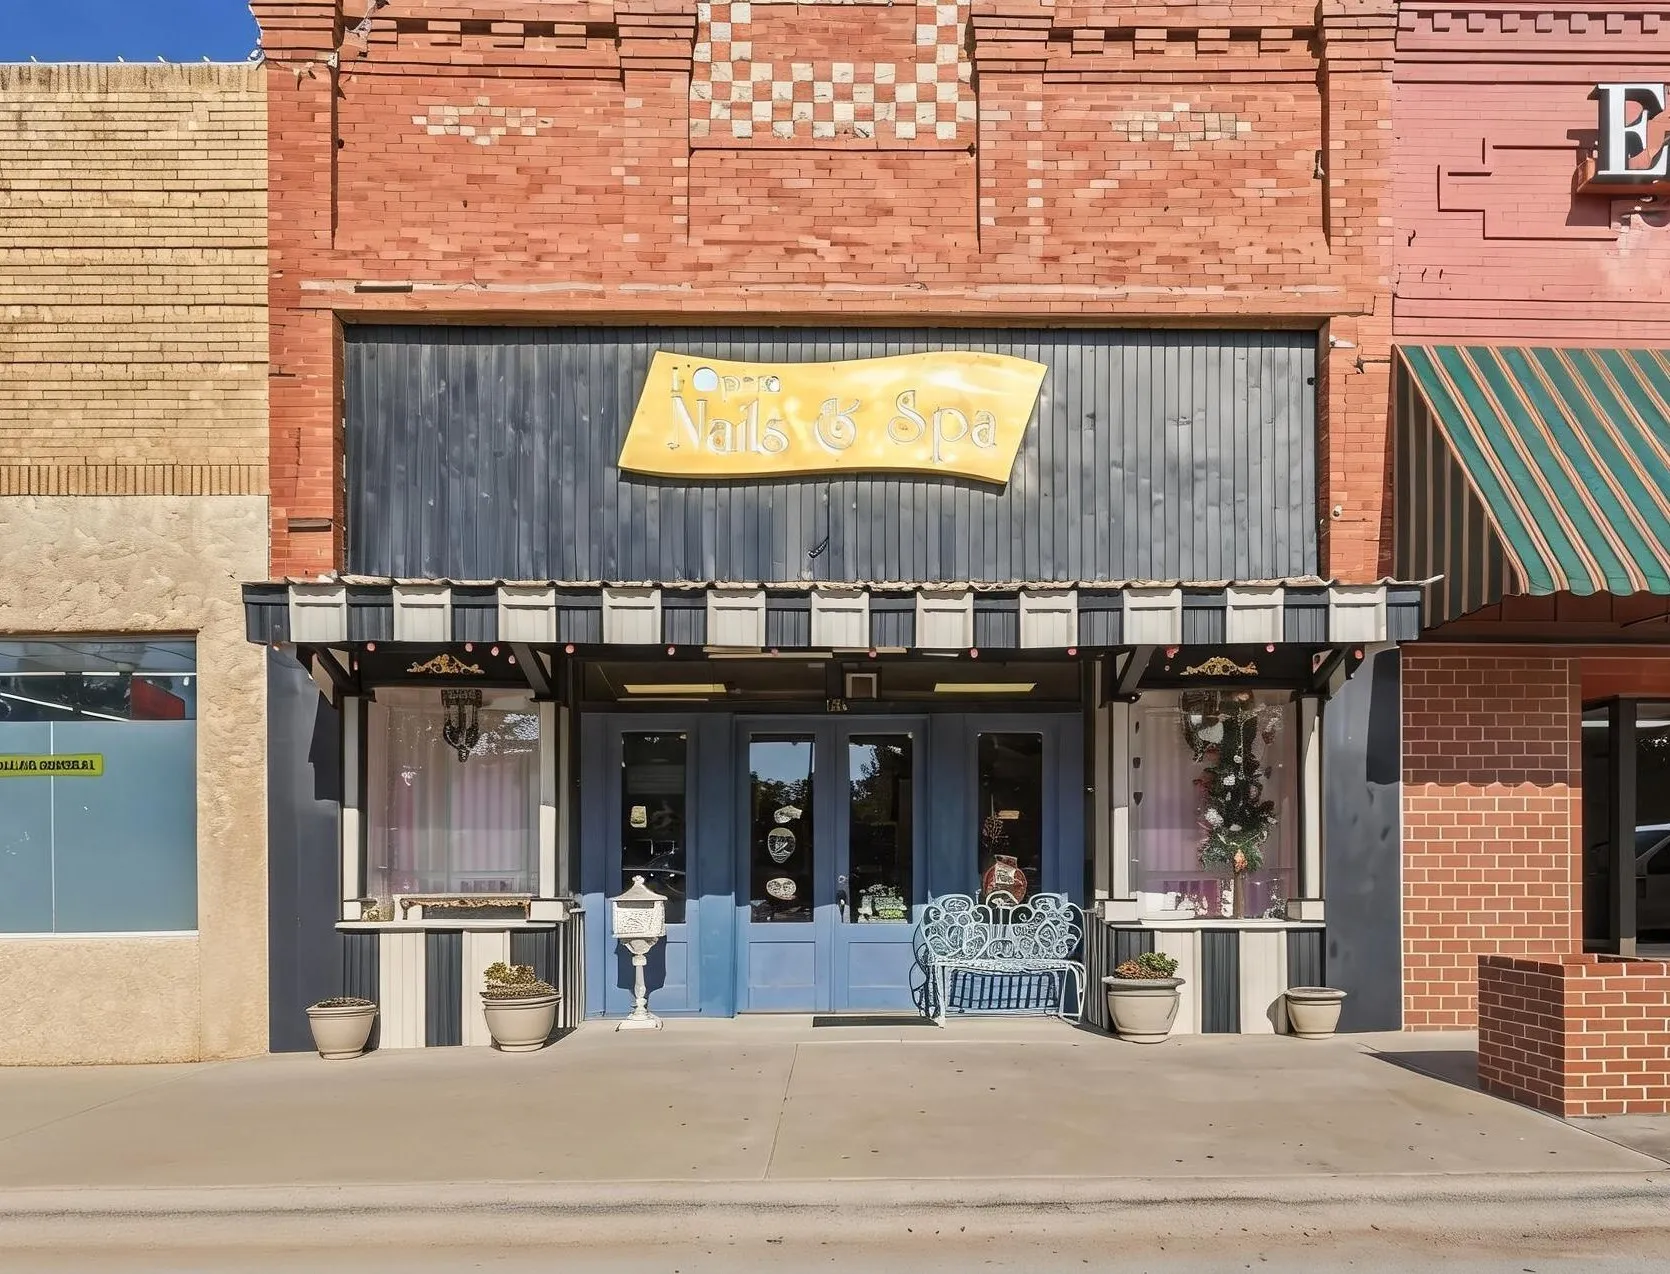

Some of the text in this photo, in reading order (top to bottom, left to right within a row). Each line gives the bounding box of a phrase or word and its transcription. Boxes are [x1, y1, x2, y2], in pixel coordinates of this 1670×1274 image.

[1596, 83, 1669, 177] E
[666, 395, 790, 455] Nails
[887, 389, 997, 464] Spa
